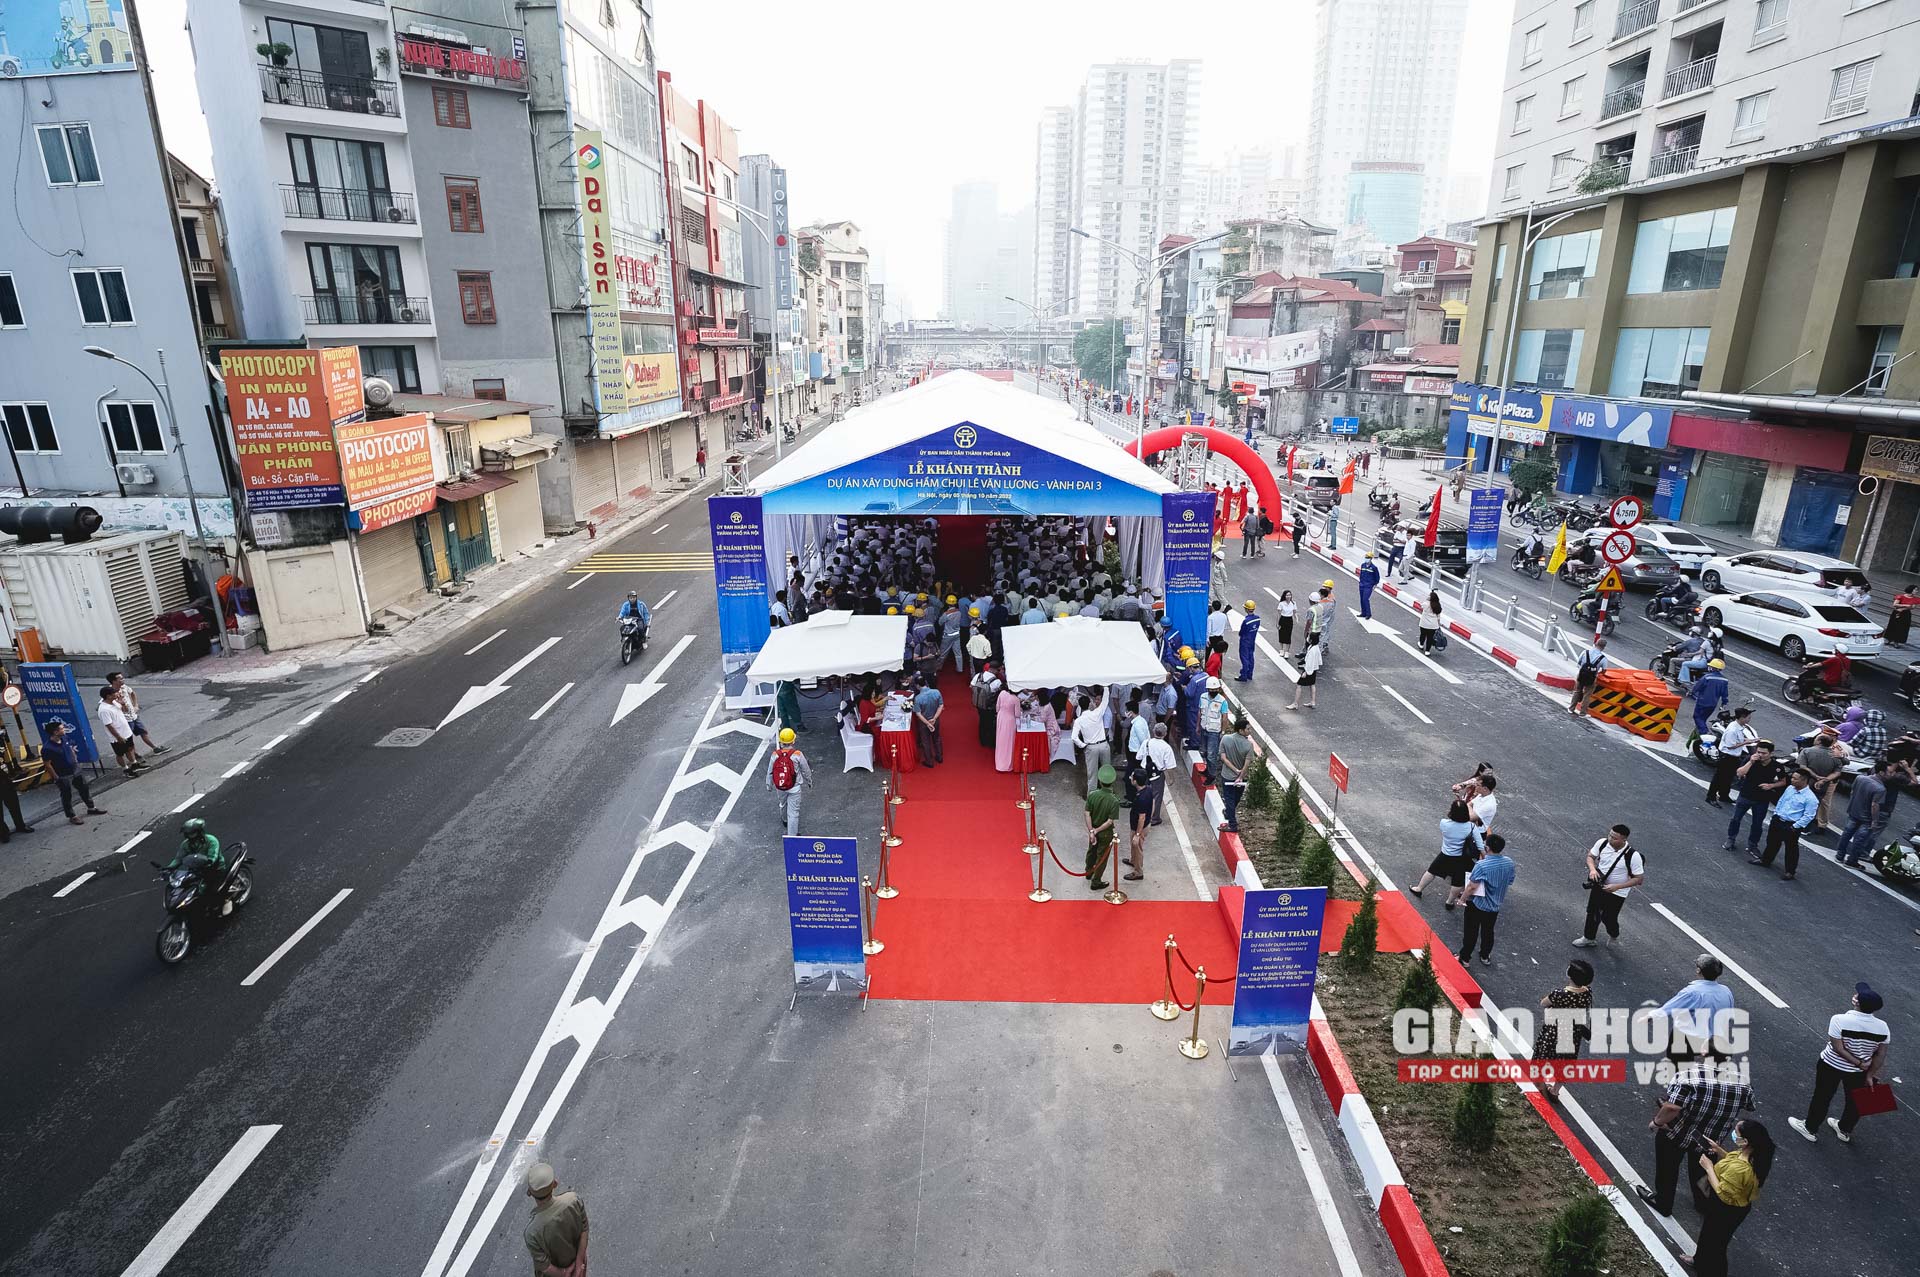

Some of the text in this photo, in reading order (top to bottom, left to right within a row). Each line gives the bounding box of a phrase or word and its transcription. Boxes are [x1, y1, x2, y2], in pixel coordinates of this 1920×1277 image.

[404, 41, 445, 66] NHÀ
[450, 48, 494, 77] NGHỈ
[221, 355, 316, 377] PHOTOCOPY
[240, 381, 307, 393] IN MÀU
[246, 398, 269, 420] A4
[1576, 411, 1596, 427] MB
[237, 440, 332, 454] VĂN PHÒNG
[344, 429, 425, 464] PHOTOCOPY
[264, 455, 313, 470] PHẨM
[909, 461, 1022, 476] LỄ KHÁNH THÀNH
[251, 475, 265, 485] Bút
[271, 471, 282, 484] Sổ
[288, 473, 303, 484] Cặp
[305, 473, 319, 482] File
[348, 467, 356, 480] IN
[358, 462, 374, 476] MÀU
[828, 478, 843, 489] DỰ
[845, 477, 860, 488] ÁN
[862, 477, 881, 488] XÂY
[883, 478, 913, 490] DỰNG
[916, 476, 939, 488] HẦM
[942, 478, 966, 488] CHUI
[969, 478, 979, 488] LÊ
[981, 478, 1001, 488] VĂN
[1004, 479, 1038, 489] LƯƠNG
[1046, 479, 1074, 490] VÀNH
[1076, 480, 1094, 490] ĐAI
[1096, 481, 1102, 490] 3
[365, 490, 432, 523] PHOTOCOPY
[1616, 506, 1636, 518] 4,75m
[26, 681, 66, 692] VIWASEEN
[1242, 930, 1253, 938] LỄ
[1287, 929, 1318, 937] THÀNH
